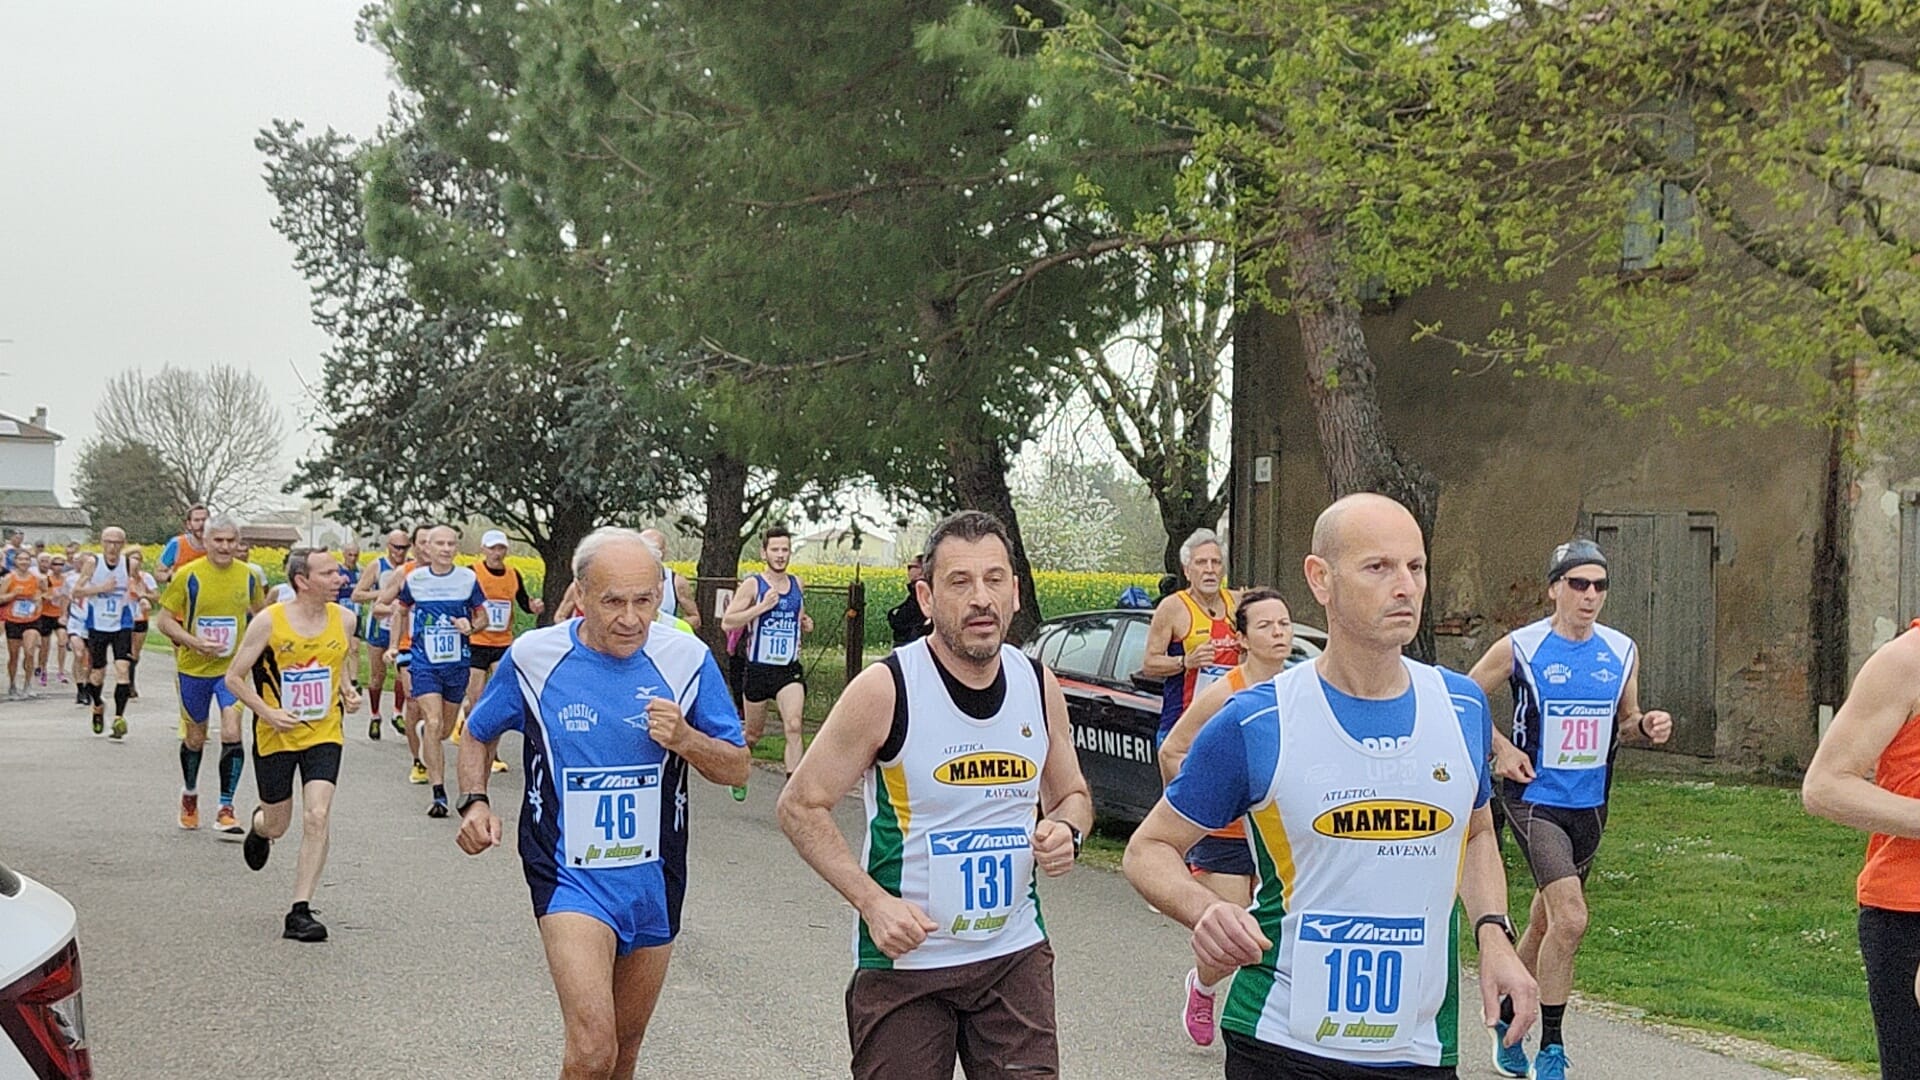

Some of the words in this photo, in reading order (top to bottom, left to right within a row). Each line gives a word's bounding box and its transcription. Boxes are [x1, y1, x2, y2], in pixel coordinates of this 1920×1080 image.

[433, 636, 455, 652] 138
[770, 638, 787, 655] 118
[291, 681, 324, 707] 290
[1561, 718, 1599, 750] 261
[942, 743, 985, 755] ATLETICA
[949, 758, 1028, 781] MAMELI
[984, 787, 1030, 798] RAVENNA
[1322, 788, 1377, 801] ATLETICA
[594, 793, 636, 840] 46
[1332, 808, 1438, 834] MAMELI
[1376, 845, 1437, 857] RAVENNA
[960, 853, 1012, 911] 131
[1324, 948, 1403, 1014] 160
